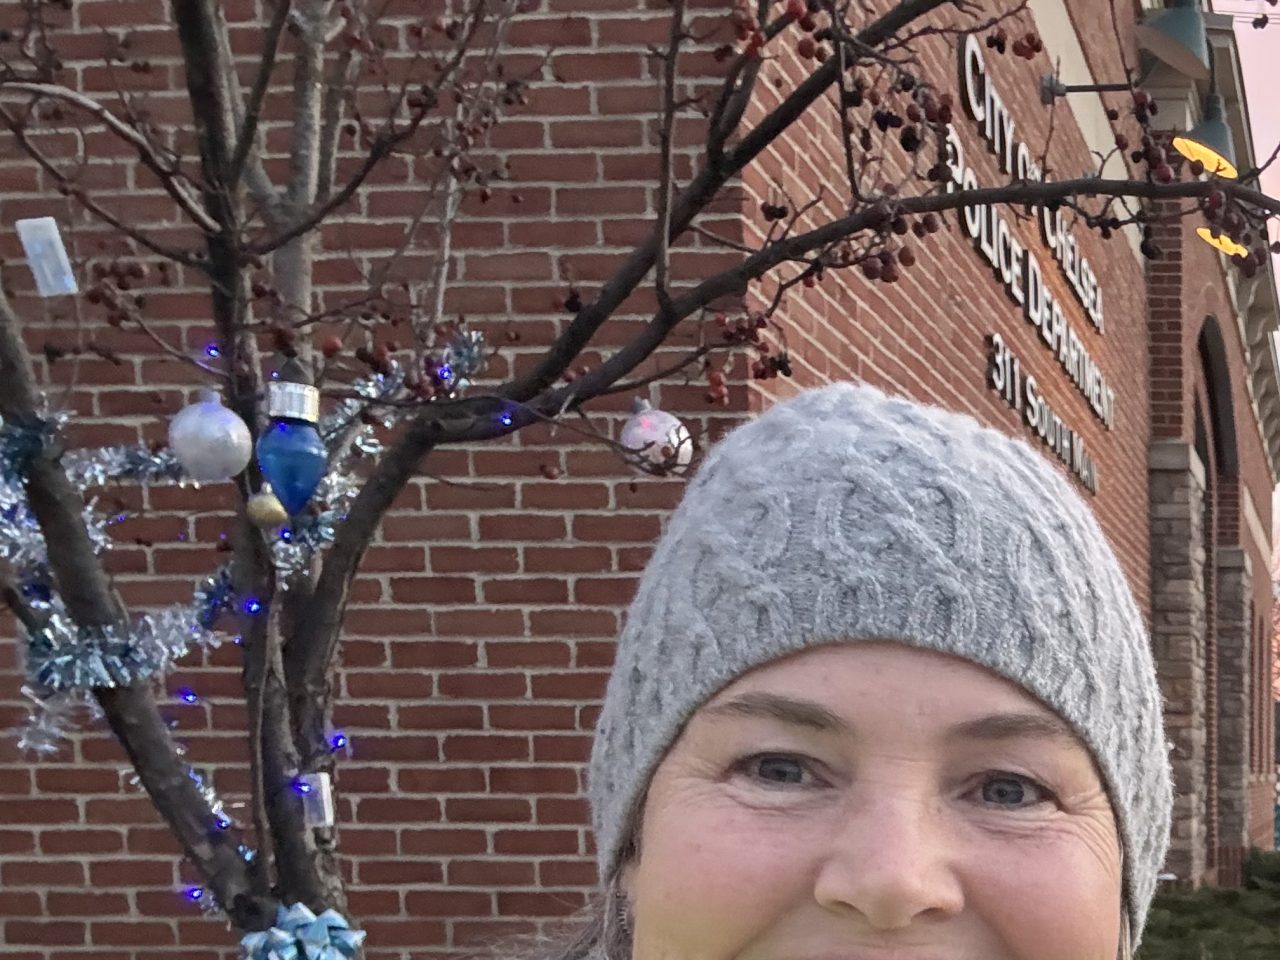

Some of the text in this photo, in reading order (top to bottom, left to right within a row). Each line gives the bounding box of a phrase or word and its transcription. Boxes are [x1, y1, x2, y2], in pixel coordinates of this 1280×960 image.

[945, 123, 1114, 431] POLICE DEPARTMENT
[965, 33, 1015, 174] CITY
[1043, 180, 1105, 334] CHELSEA
[993, 332, 1021, 410] 311
[1026, 375, 1071, 465] SOUTH
